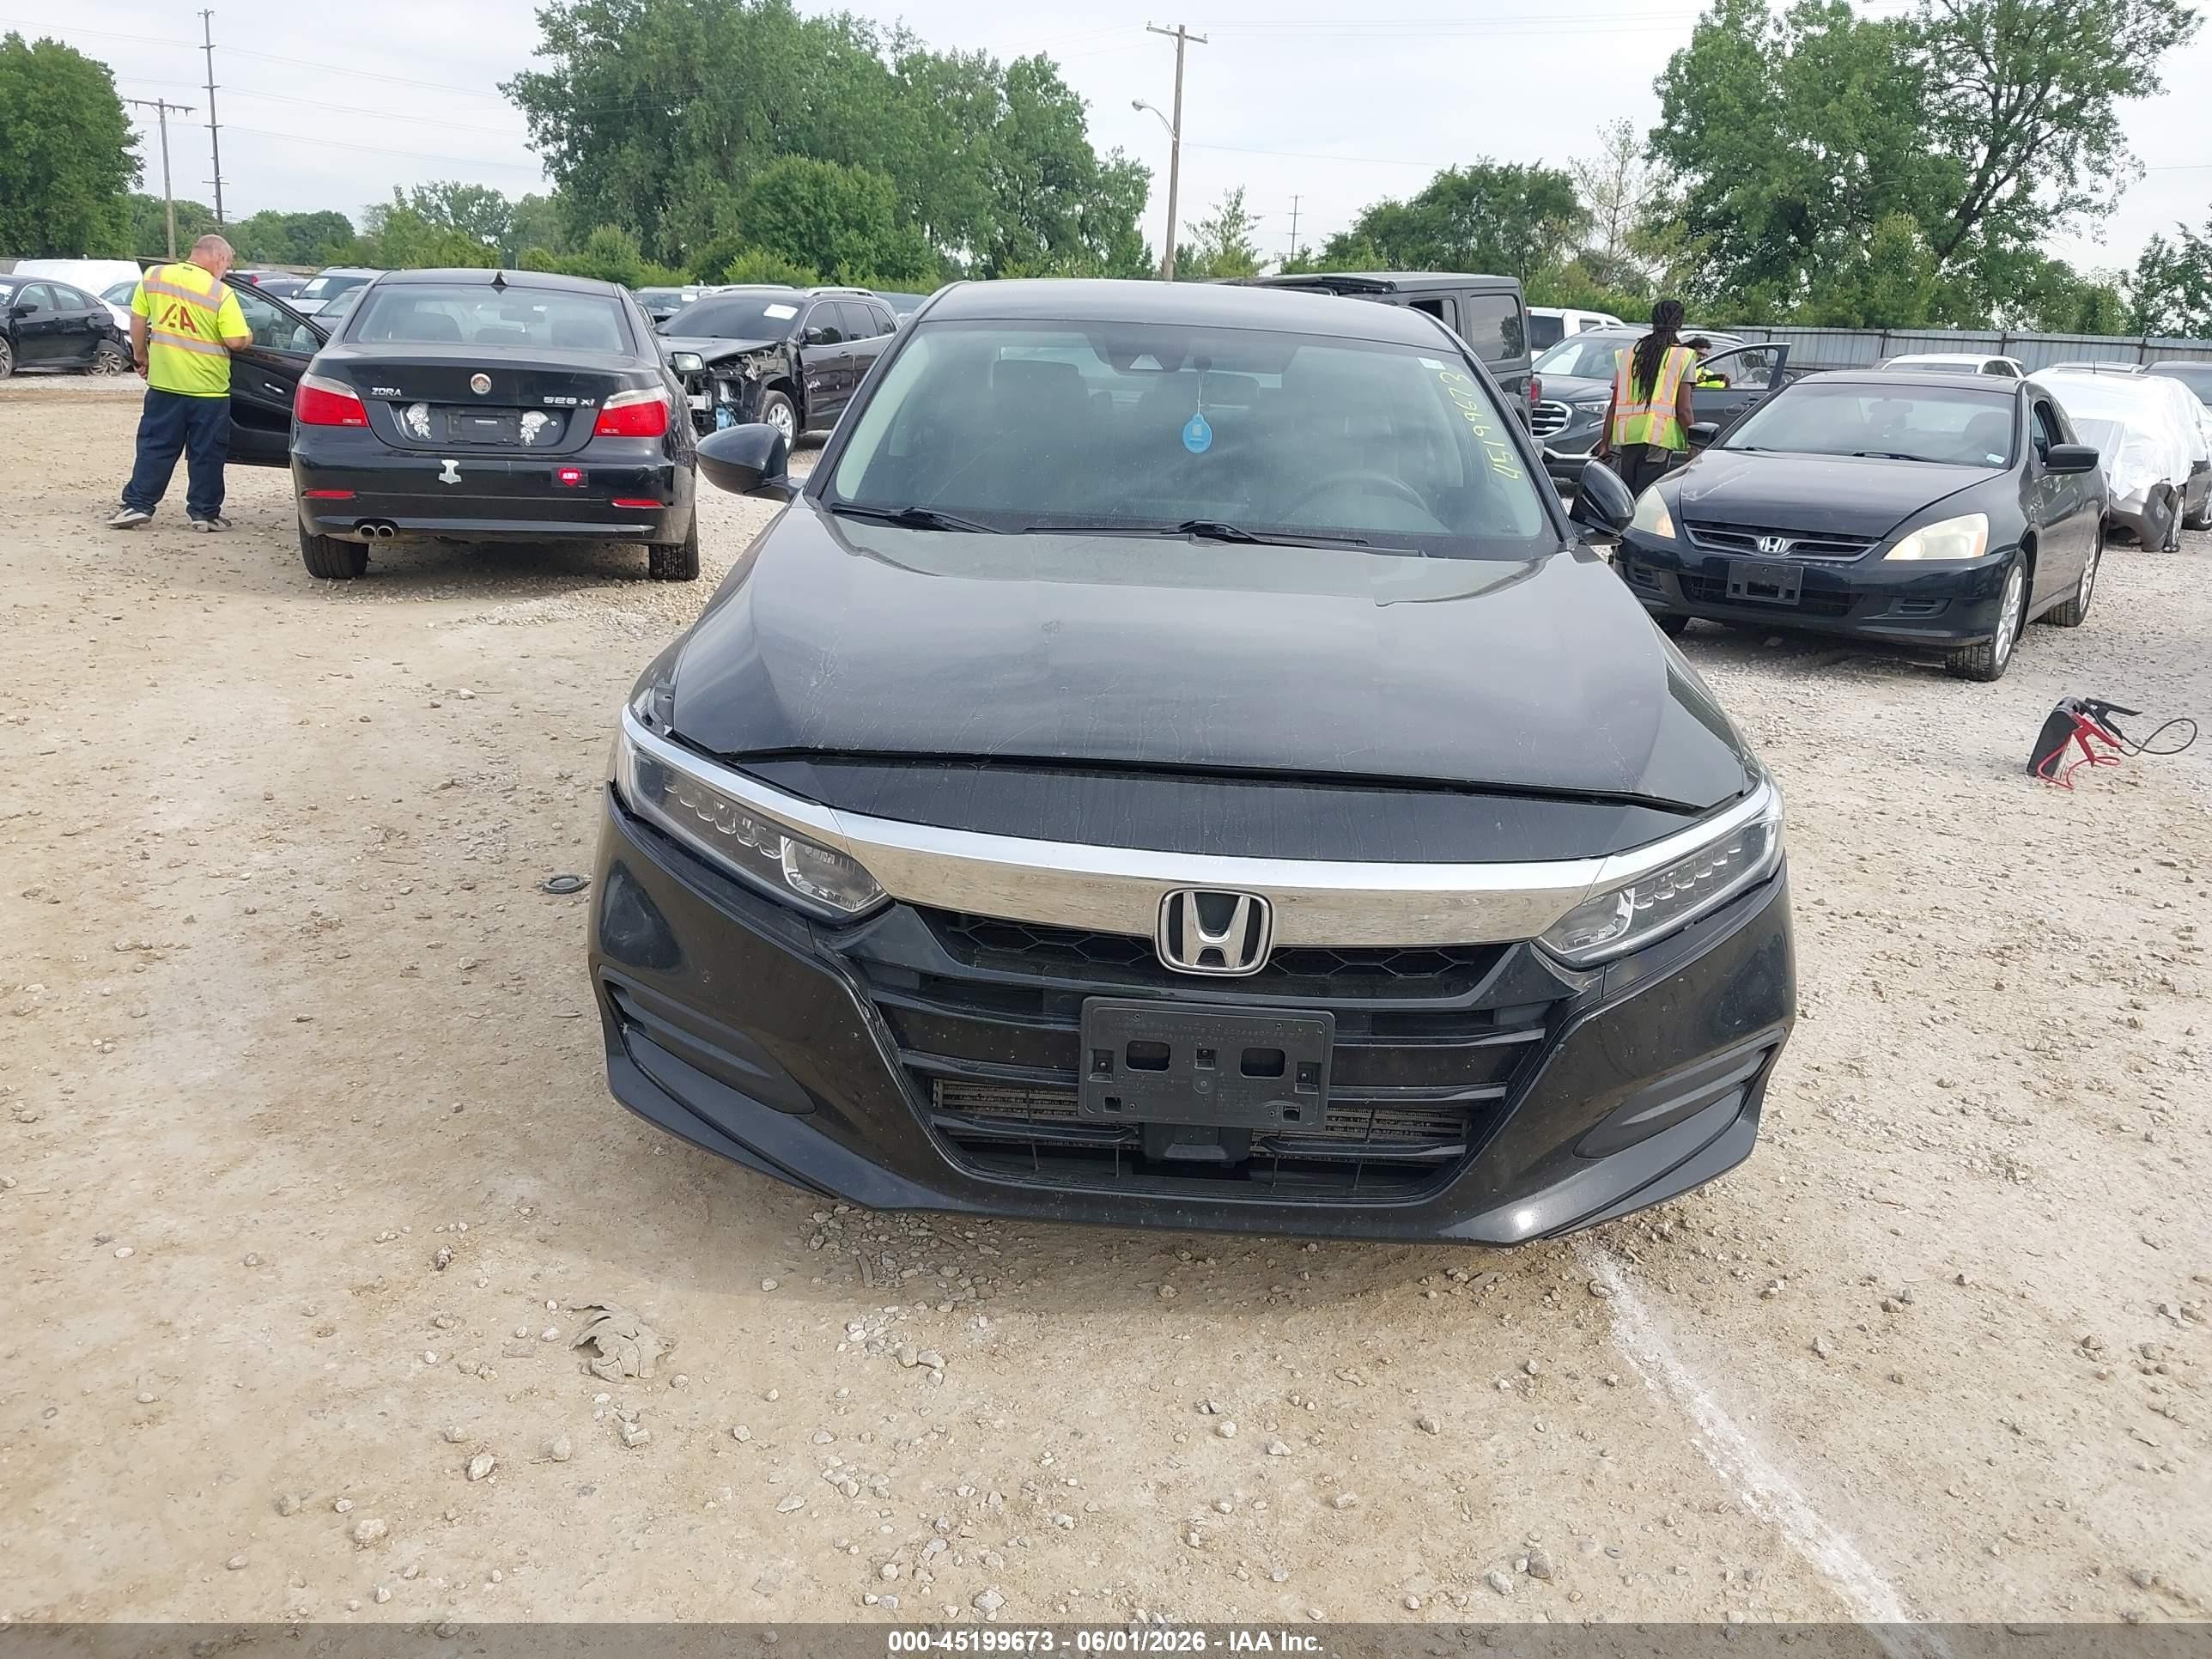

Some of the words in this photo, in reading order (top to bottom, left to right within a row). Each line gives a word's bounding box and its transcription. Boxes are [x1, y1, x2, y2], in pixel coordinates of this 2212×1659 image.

[370, 386, 402, 397] ZORA
[543, 396, 578, 404] 528
[1439, 371, 1522, 479] 45199673
